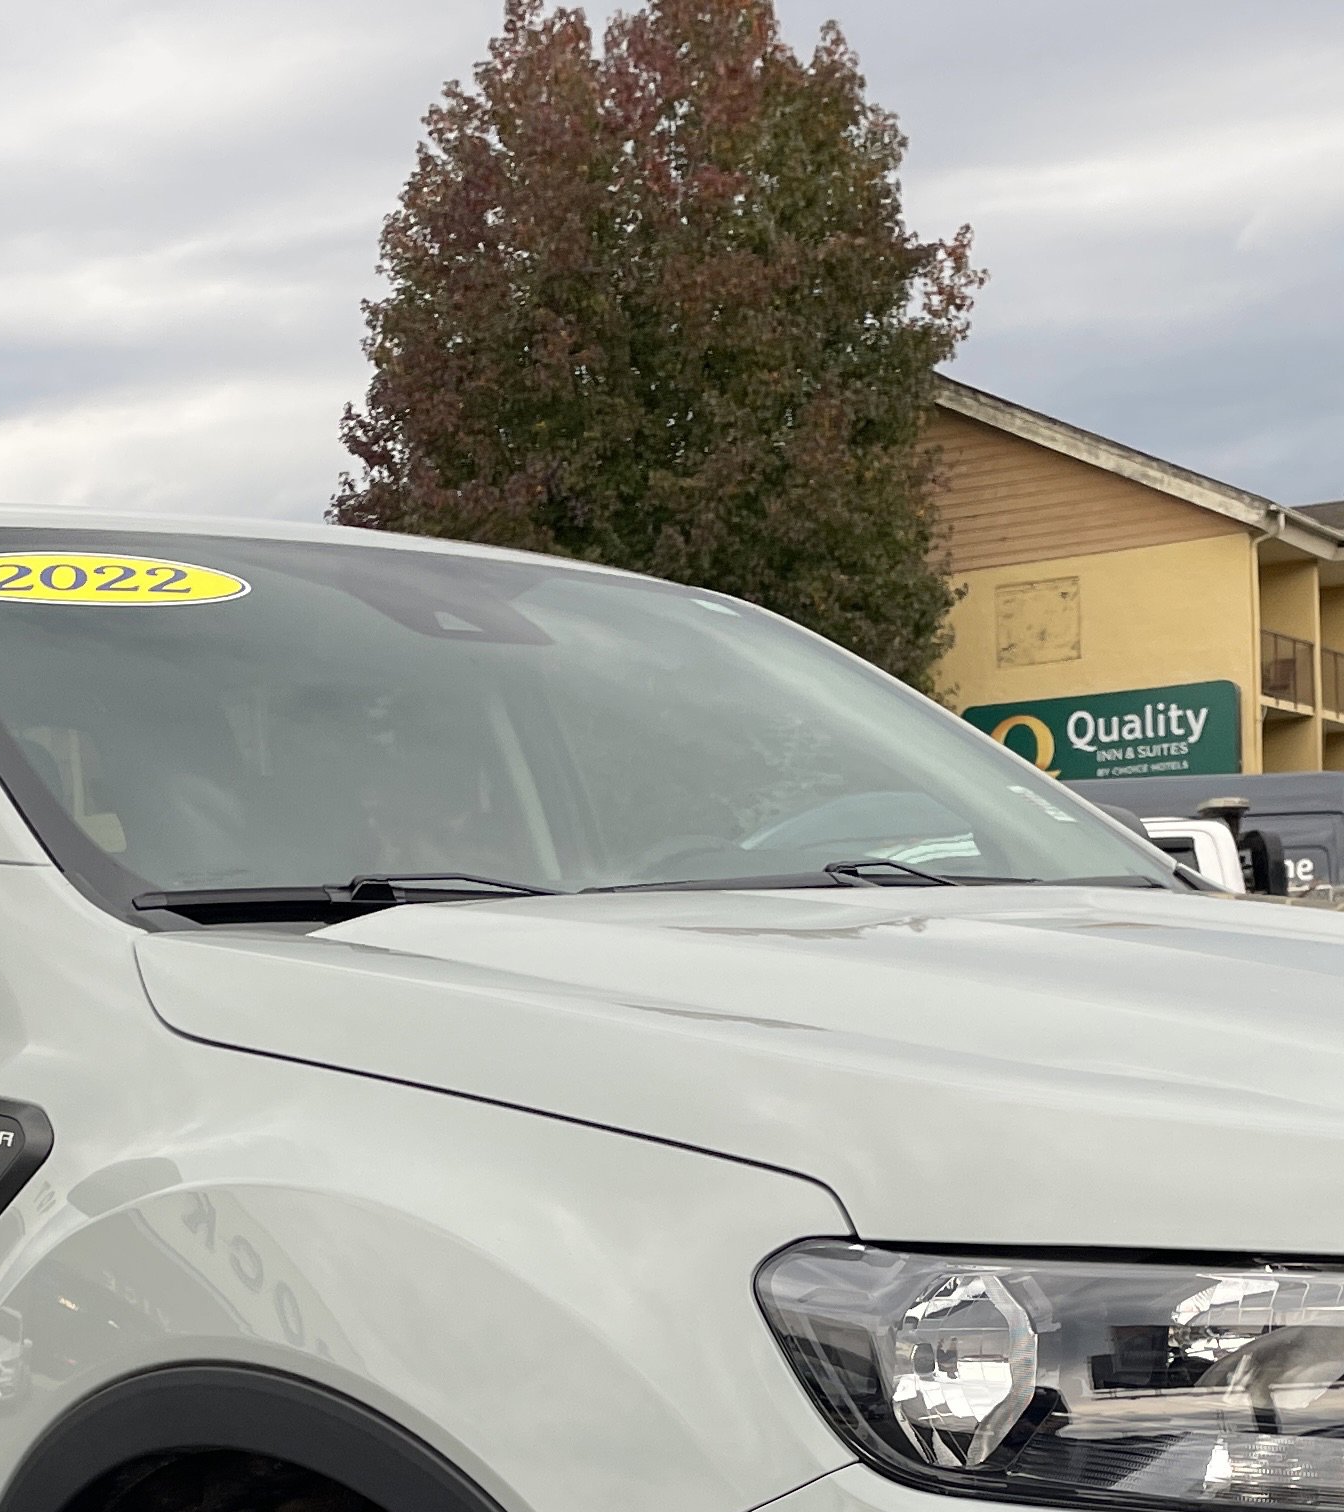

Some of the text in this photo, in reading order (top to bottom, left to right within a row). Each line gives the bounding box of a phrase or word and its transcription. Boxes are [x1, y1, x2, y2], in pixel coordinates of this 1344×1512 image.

[1066, 703, 1208, 752] Quality
[1096, 748, 1123, 762] INN
[1136, 741, 1189, 758] SUITES
